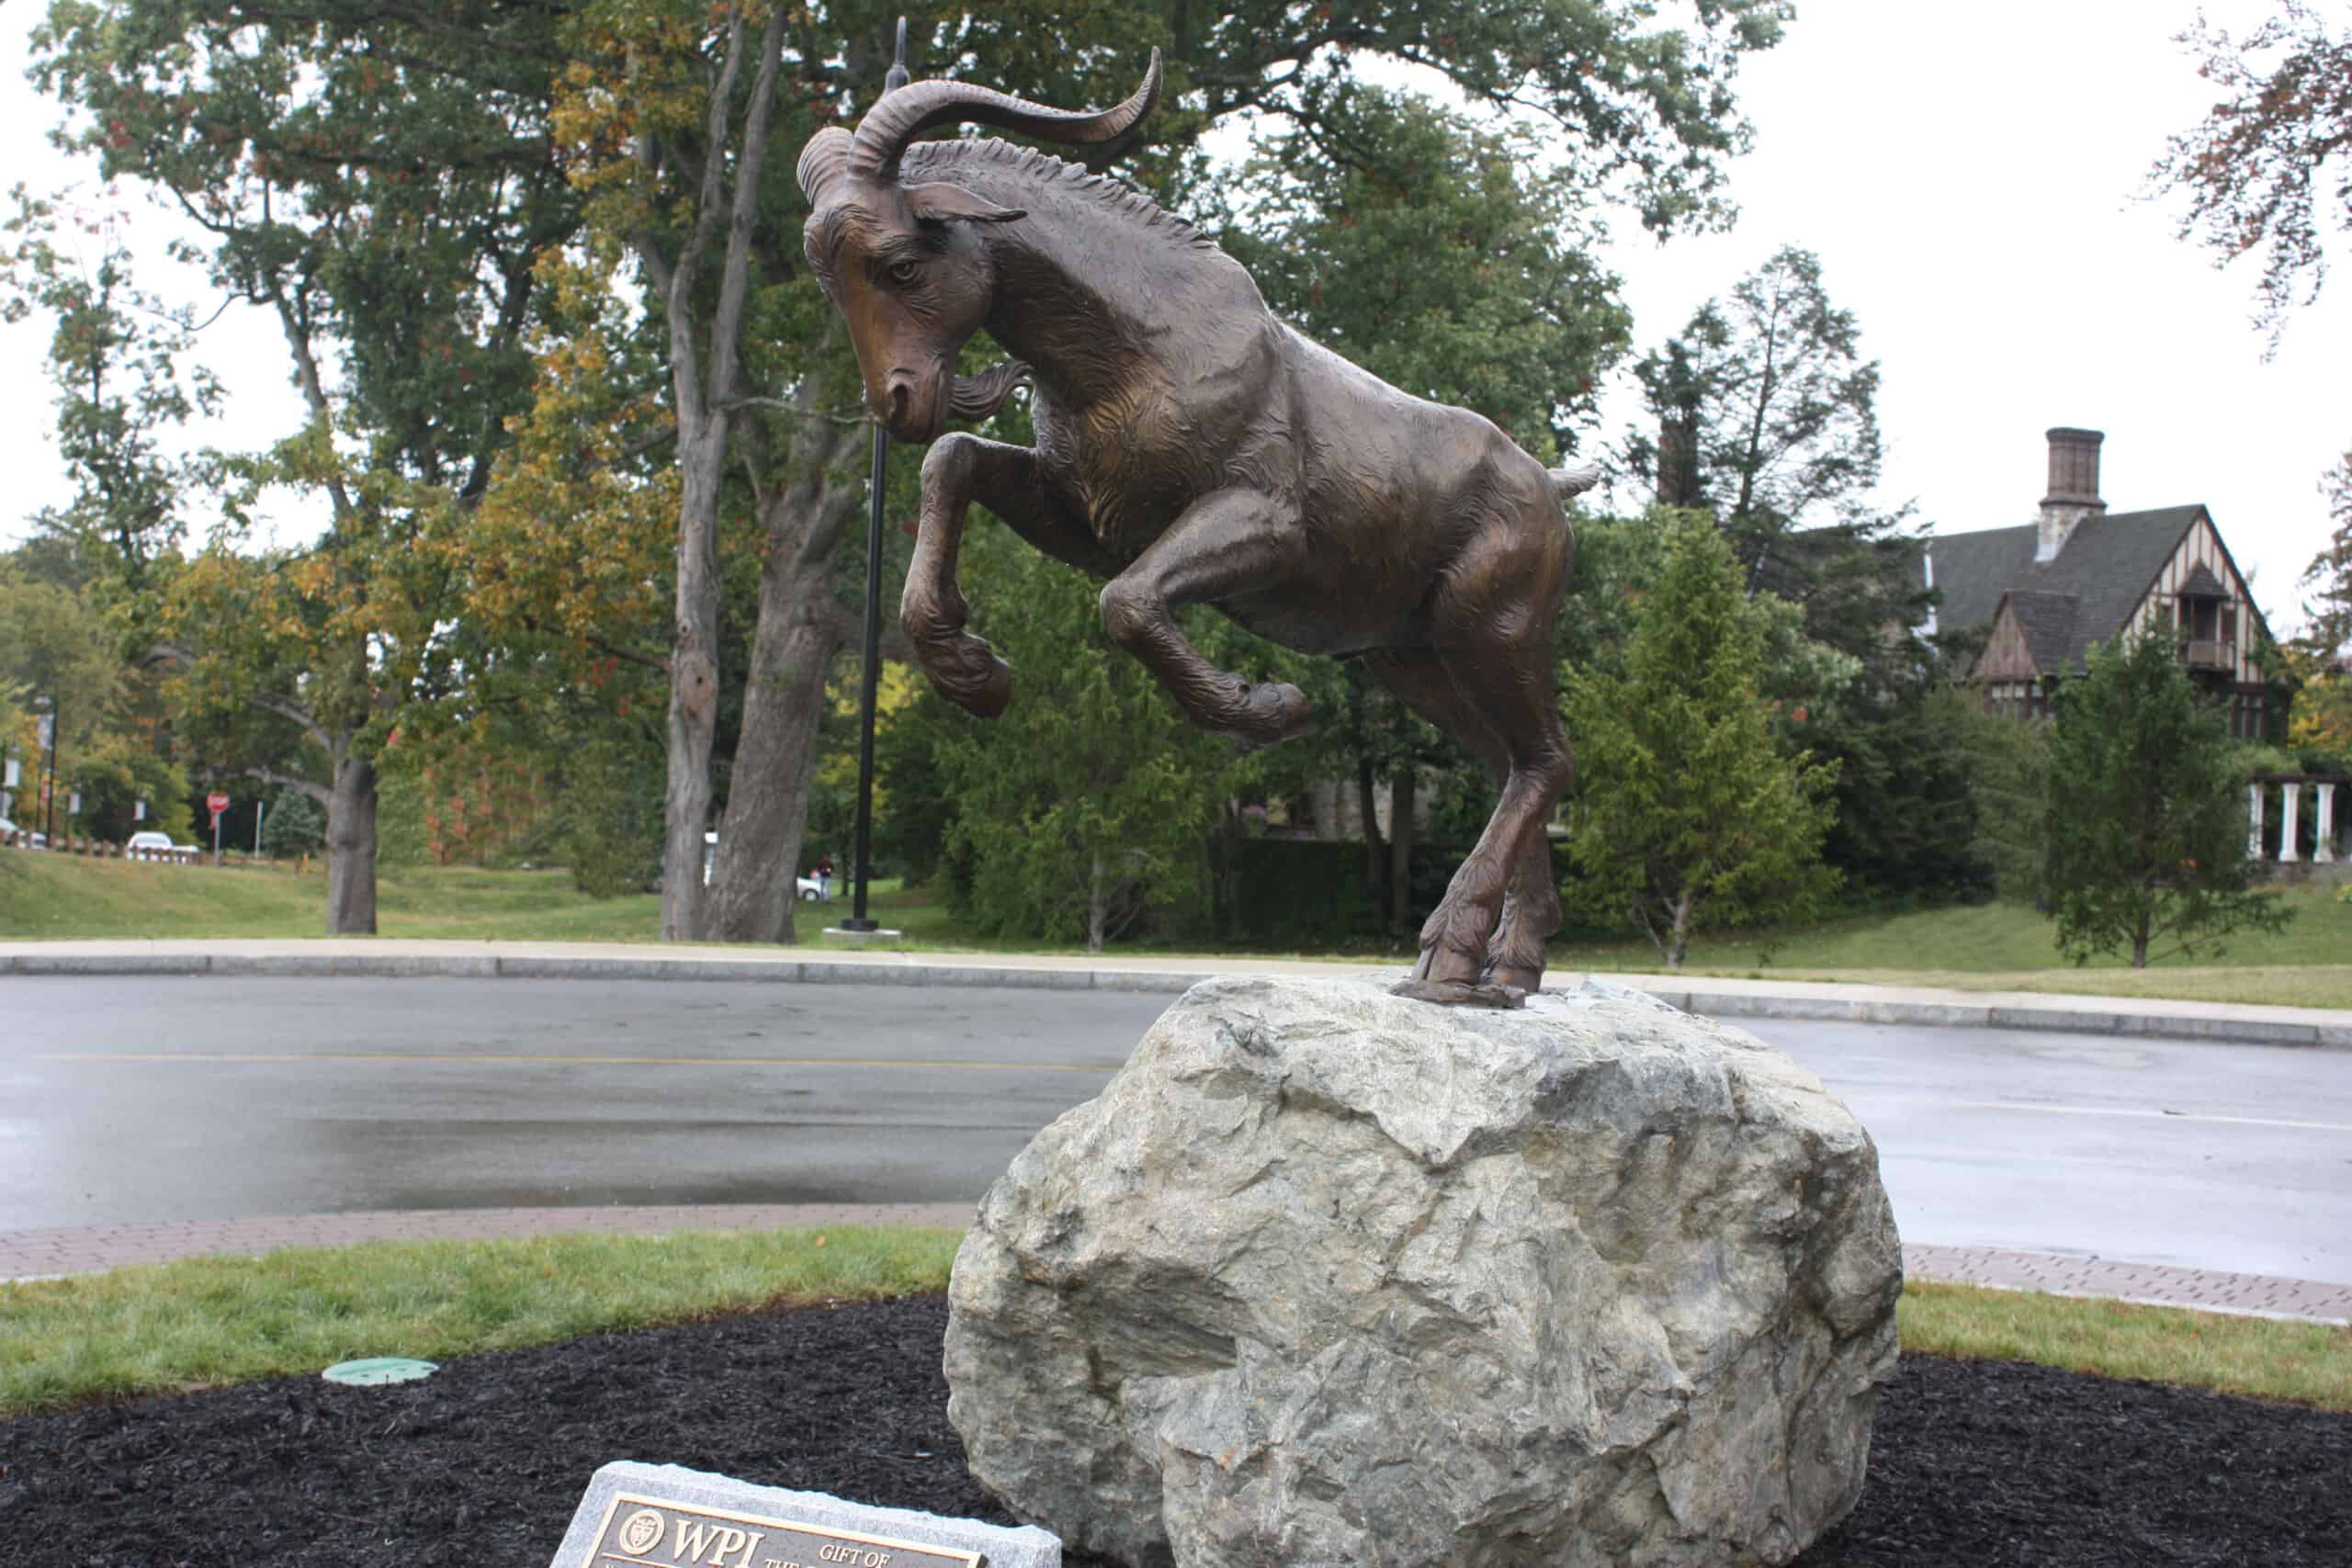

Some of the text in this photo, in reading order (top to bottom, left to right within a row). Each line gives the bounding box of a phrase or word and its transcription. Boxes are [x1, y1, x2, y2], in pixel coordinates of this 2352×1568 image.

[673, 1519, 764, 1568] WPI
[819, 1544, 891, 1568] GIFT OF
